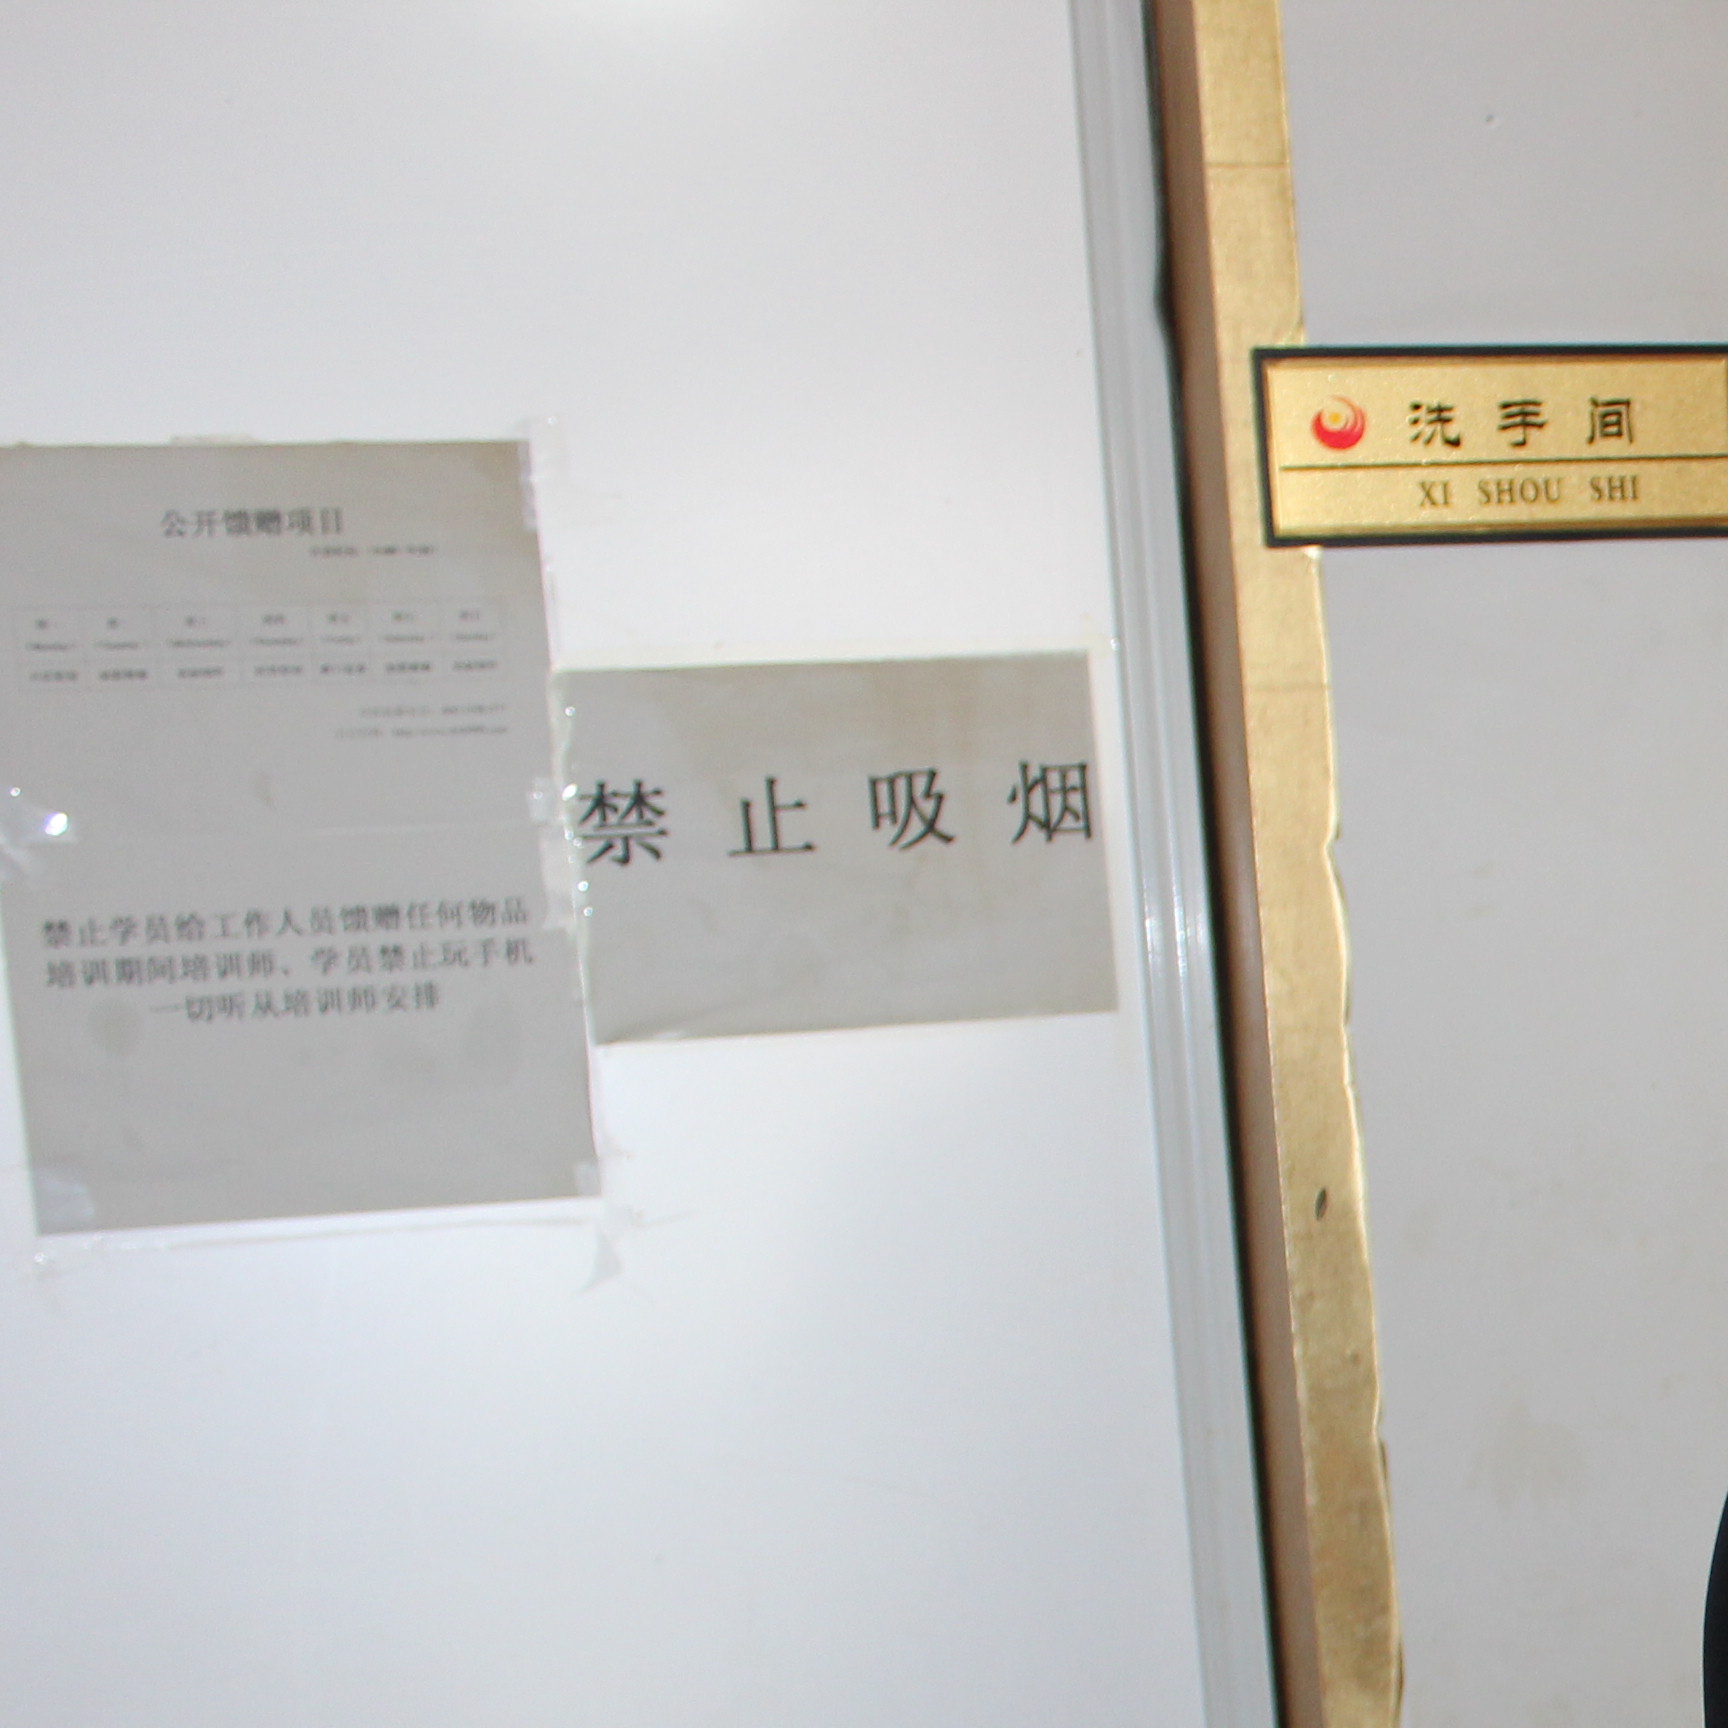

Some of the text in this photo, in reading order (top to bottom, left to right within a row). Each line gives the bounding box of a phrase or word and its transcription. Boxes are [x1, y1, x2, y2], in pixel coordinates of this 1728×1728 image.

[1408, 397, 1636, 447] 洗手间
[1417, 475, 1641, 509] XI SHOU SHI
[579, 760, 1094, 866] 禁止吸烟
[150, 980, 441, 1023] 一切听从培训师安排
